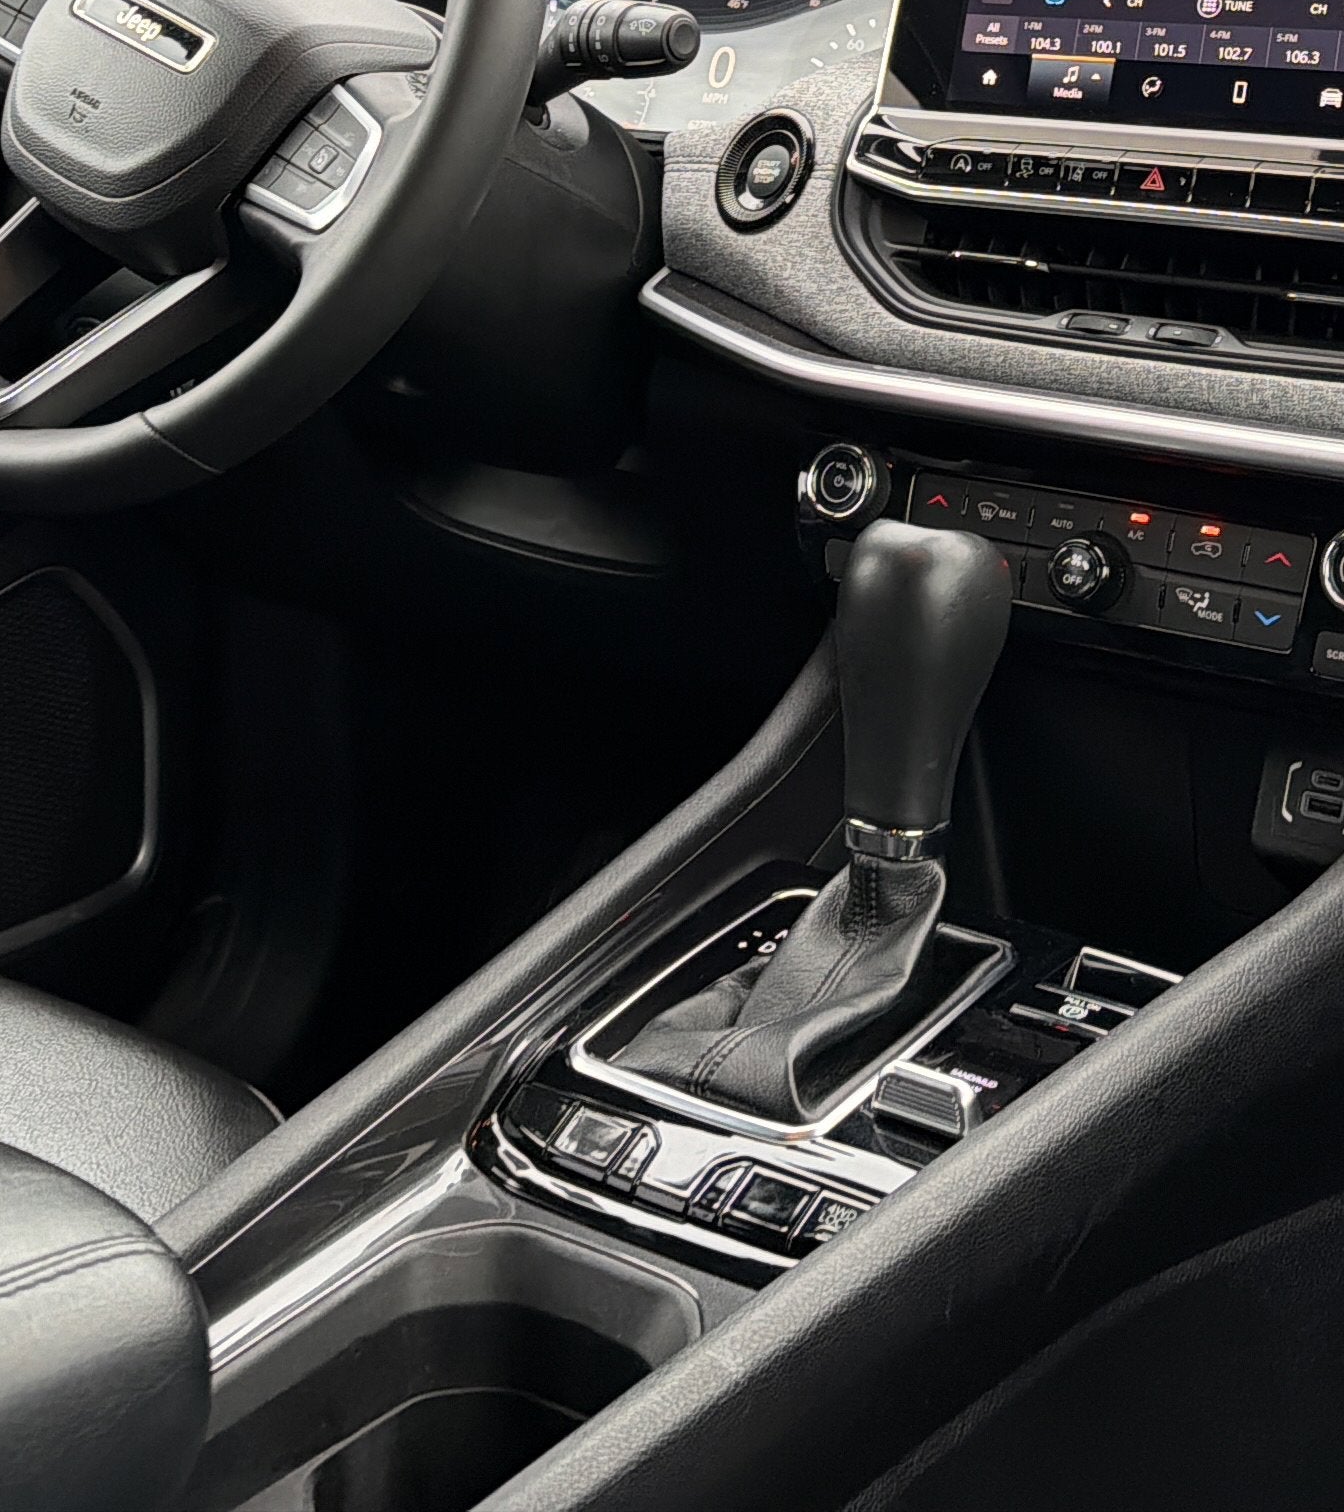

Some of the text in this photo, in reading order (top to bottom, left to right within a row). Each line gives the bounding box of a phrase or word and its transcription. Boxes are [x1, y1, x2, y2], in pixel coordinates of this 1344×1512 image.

[1224, 0, 1254, 13] TUNE
[1309, 3, 1329, 15] CH
[116, 5, 163, 42] Jeep
[986, 22, 1000, 33] All
[1023, 21, 1044, 31] 1-FM
[1082, 24, 1104, 34] 2-FM
[1145, 27, 1167, 37] 3-FM
[1209, 30, 1232, 40] 4-FM
[1276, 33, 1299, 44] 5-FM
[846, 38, 865, 52] 60
[975, 34, 1008, 46] Presets
[1030, 37, 1061, 51] 104.3
[1090, 40, 1122, 54] 100.1
[1153, 43, 1187, 58] 101.5
[1218, 46, 1253, 61] 102.7
[1285, 50, 1321, 65] 106.3
[708, 46, 736, 89] 0
[702, 92, 729, 105] MPH
[1053, 87, 1083, 100] Media
[977, 161, 993, 172] OFF
[1038, 166, 1055, 176] OFF
[1092, 171, 1109, 181] OFF
[998, 509, 1018, 521] MAX
[1050, 517, 1074, 530] AUTO
[1127, 529, 1146, 541] A/C
[1062, 573, 1084, 587] OFF
[1197, 608, 1224, 623] MODE
